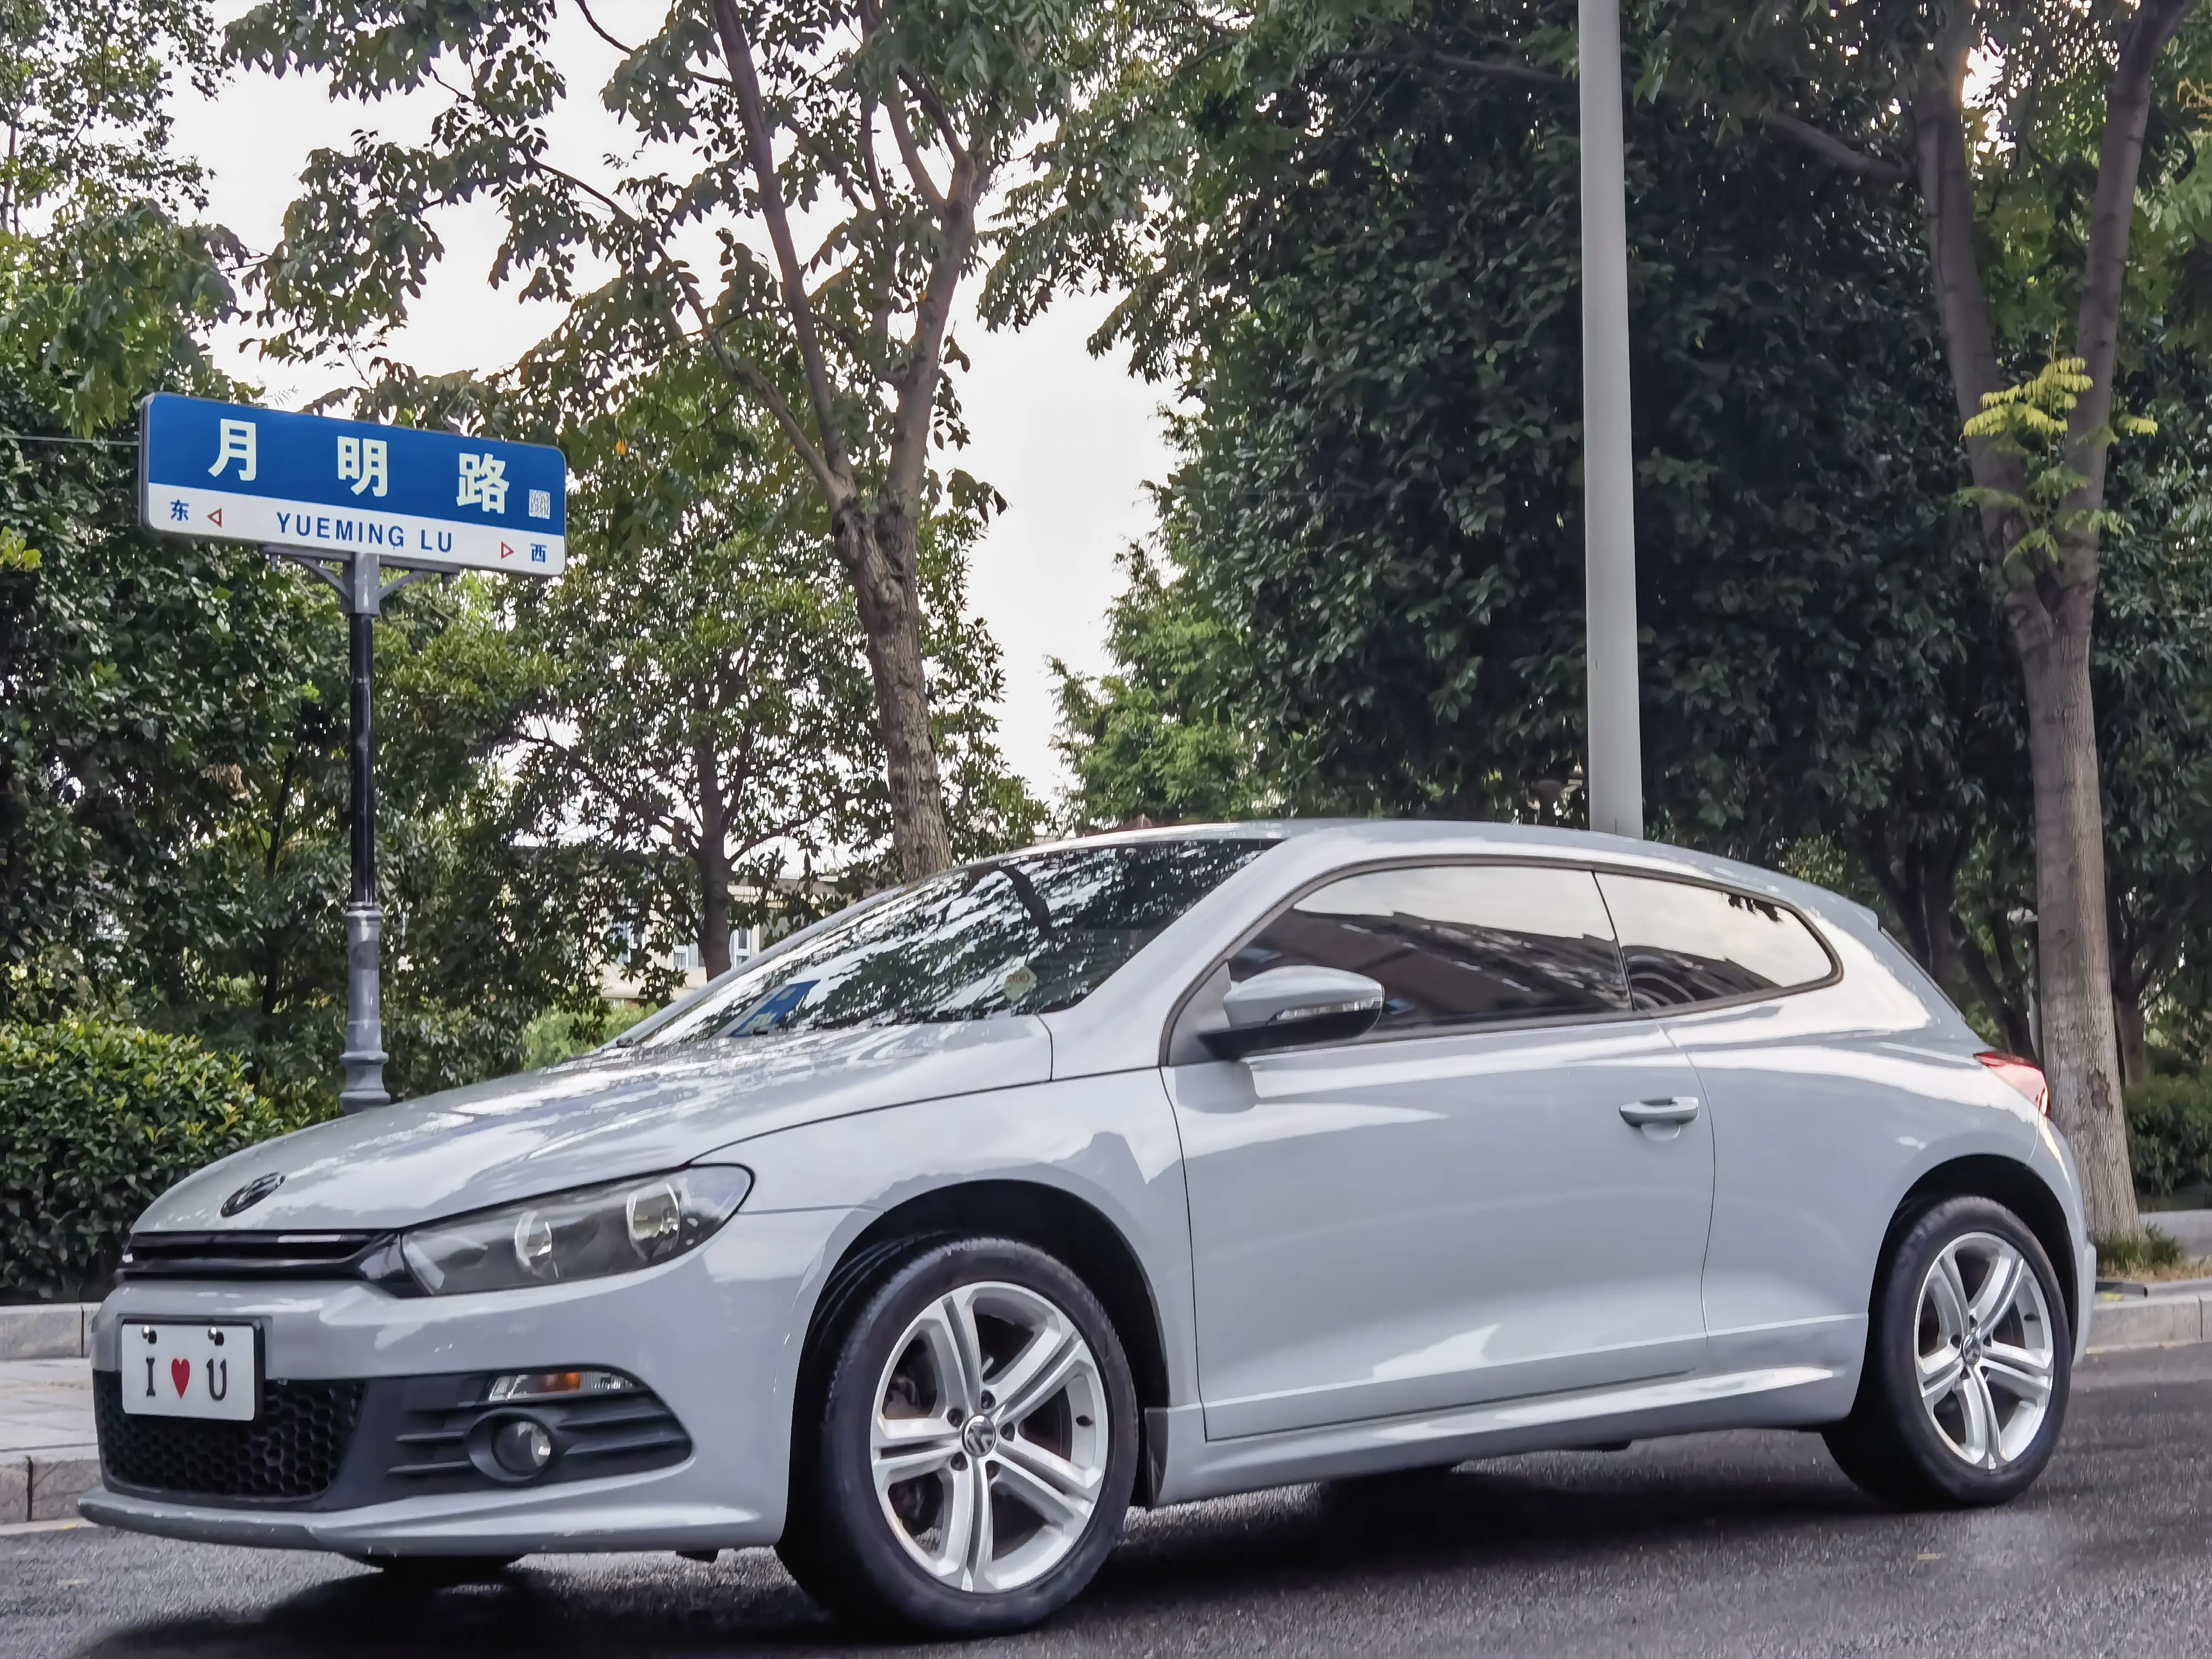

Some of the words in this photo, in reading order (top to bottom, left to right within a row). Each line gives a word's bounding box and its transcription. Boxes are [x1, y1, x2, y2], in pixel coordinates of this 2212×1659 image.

[208, 419, 510, 514] 月明路
[170, 499, 190, 521] 东
[276, 511, 403, 548] YUEMING
[421, 529, 452, 553] LU
[530, 543, 547, 563] 西
[146, 1357, 156, 1397] I
[206, 1358, 227, 1401] U
